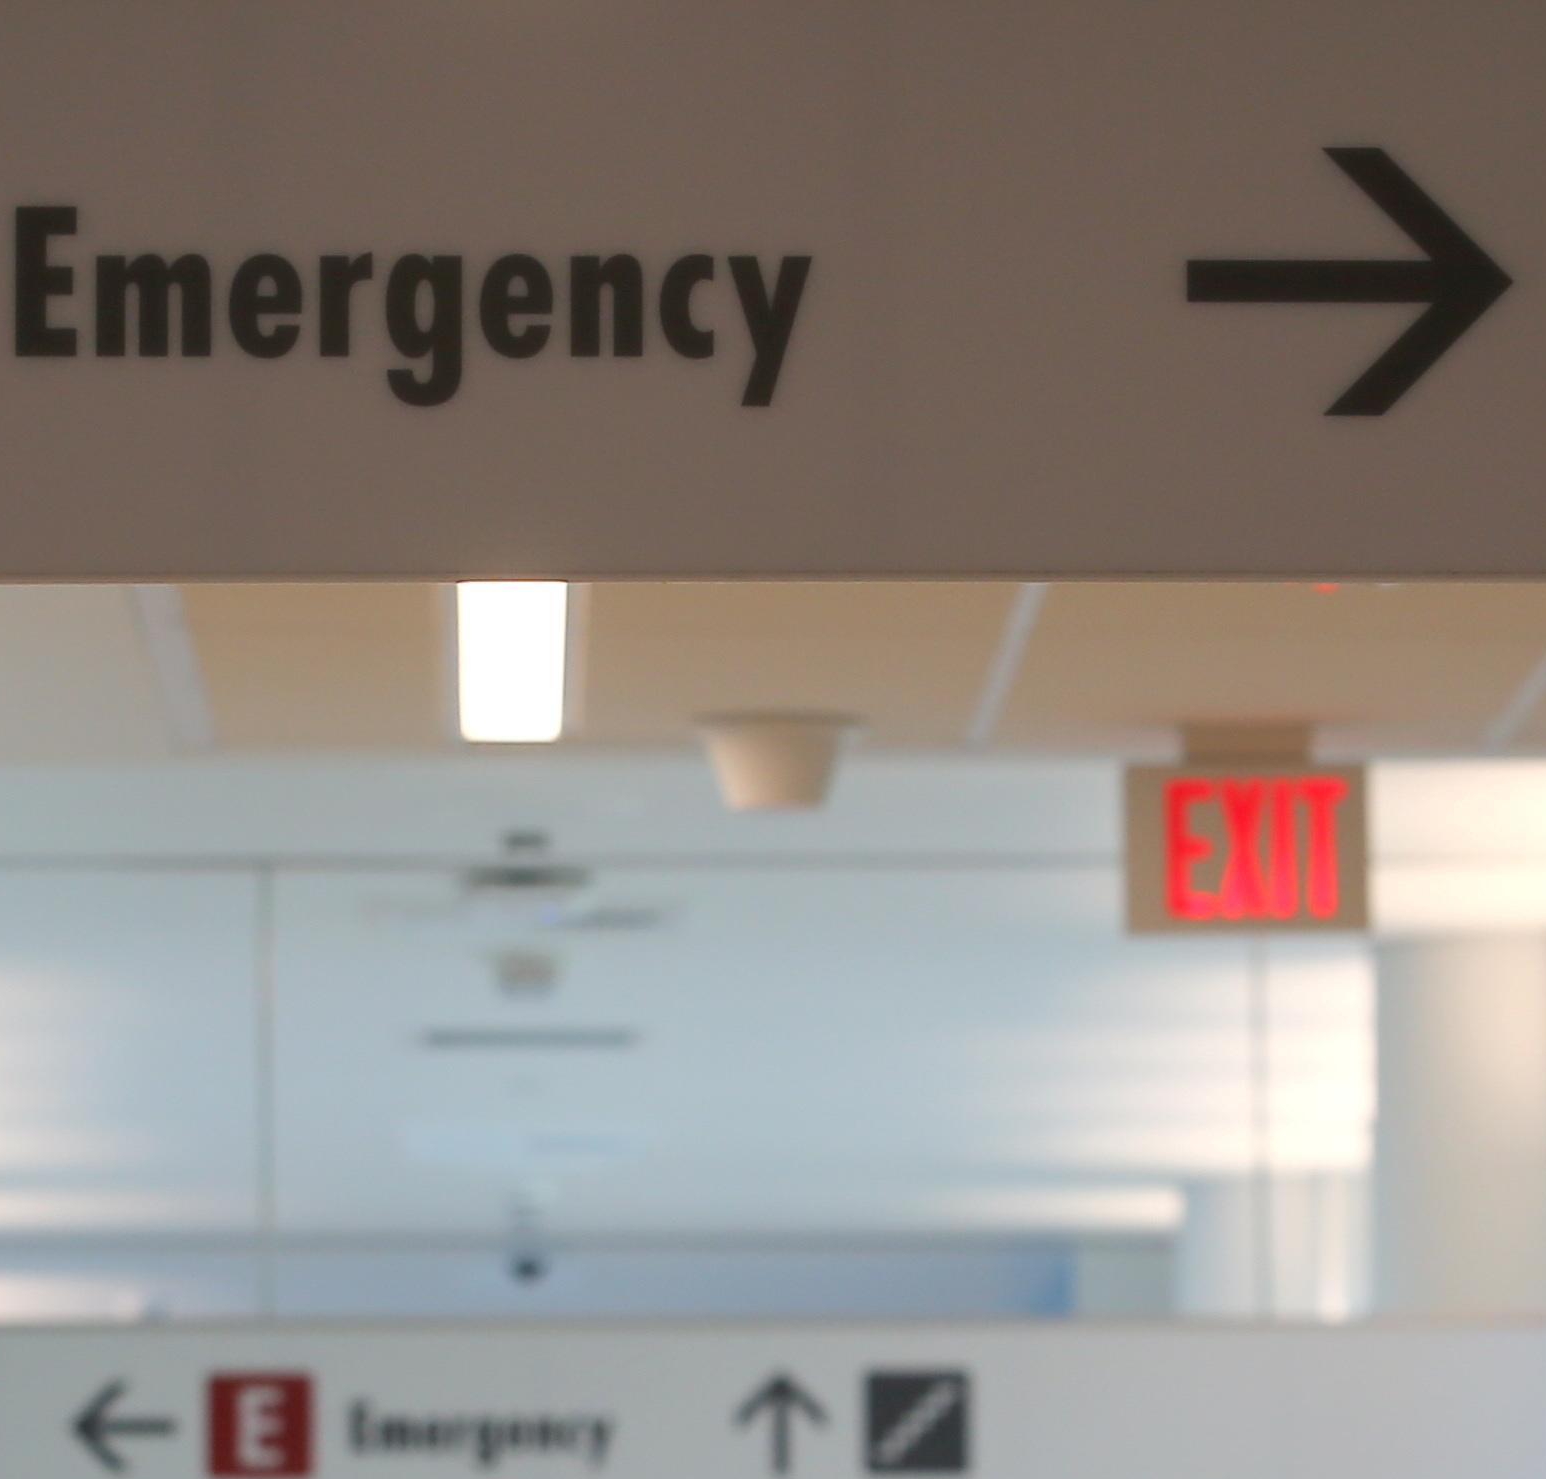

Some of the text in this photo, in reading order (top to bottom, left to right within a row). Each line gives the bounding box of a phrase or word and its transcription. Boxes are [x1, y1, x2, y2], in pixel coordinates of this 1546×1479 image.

[13, 204, 812, 408] Emergency
[1164, 774, 1347, 920] EXIT
[236, 1385, 611, 1470] E Emergency
